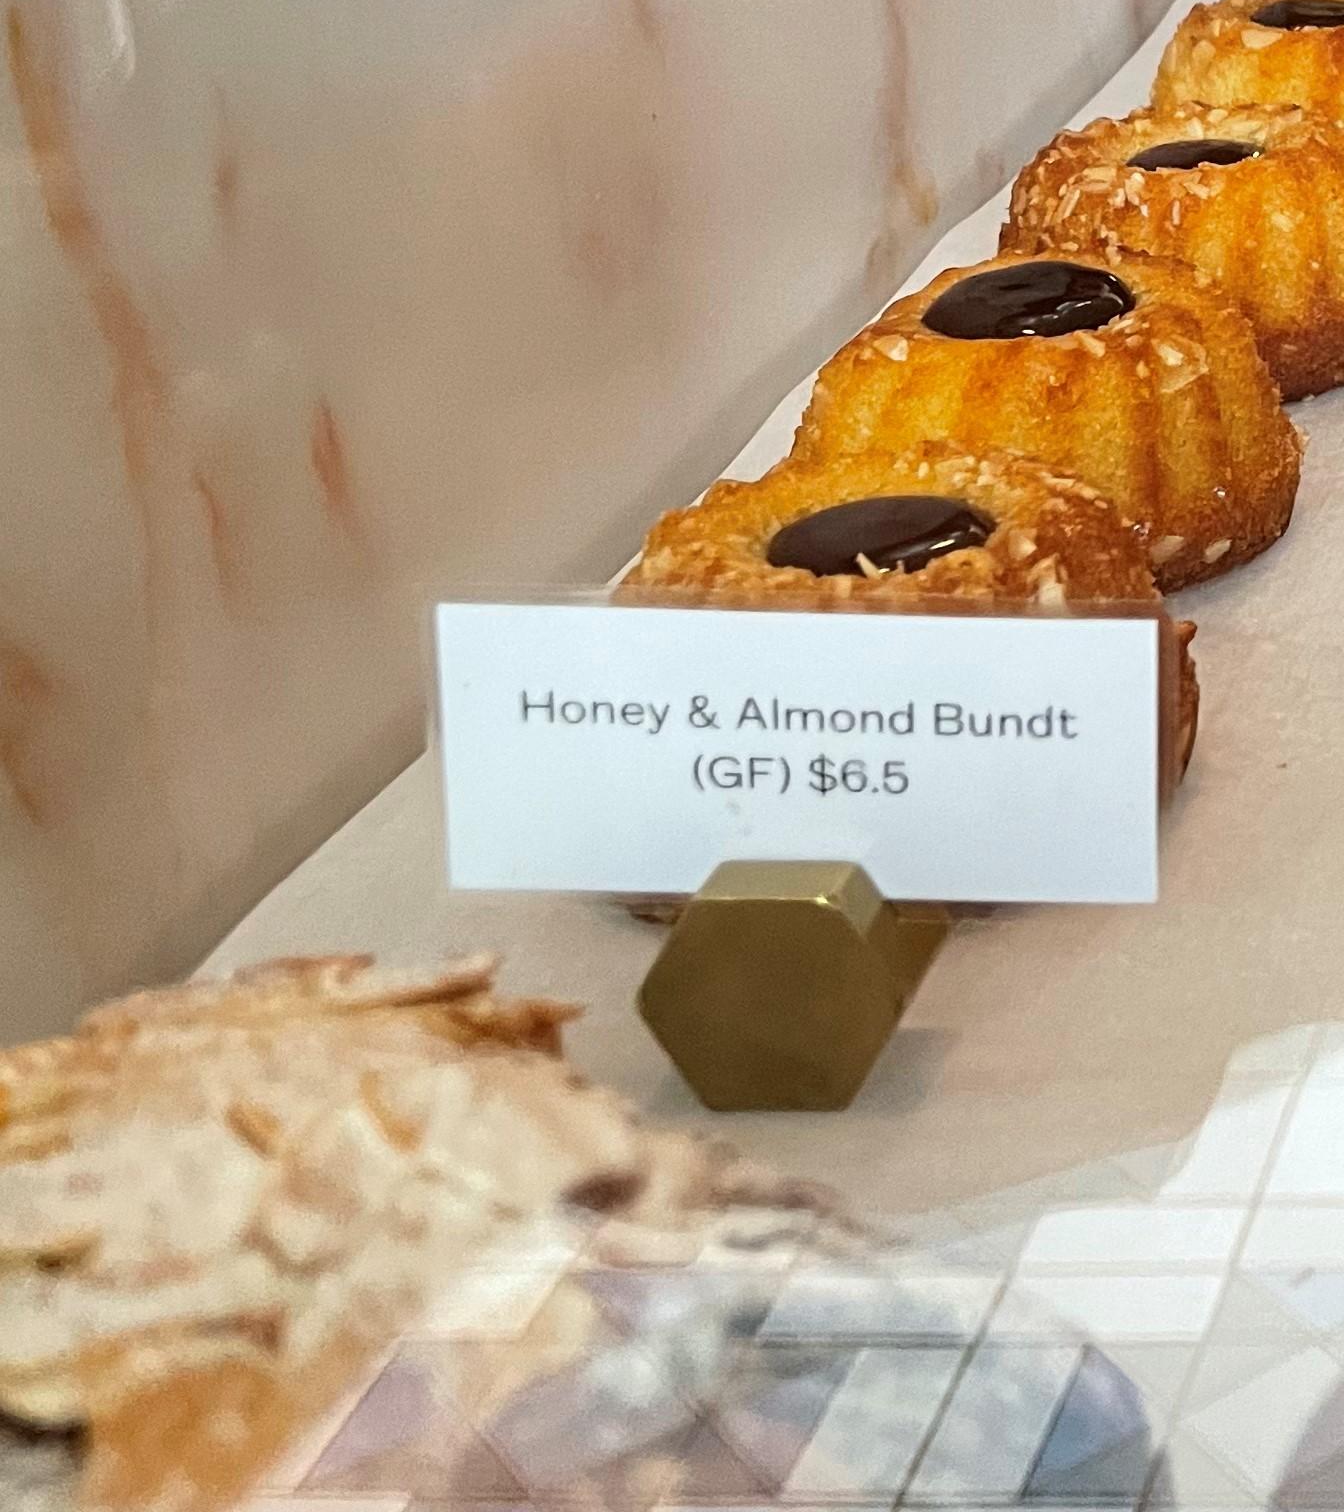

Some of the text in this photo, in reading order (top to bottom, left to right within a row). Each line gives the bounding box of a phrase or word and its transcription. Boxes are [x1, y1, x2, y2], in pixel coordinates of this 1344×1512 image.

[519, 689, 1079, 740] Honey & Almond Bundt
[692, 752, 910, 797] (GF) $6.5
